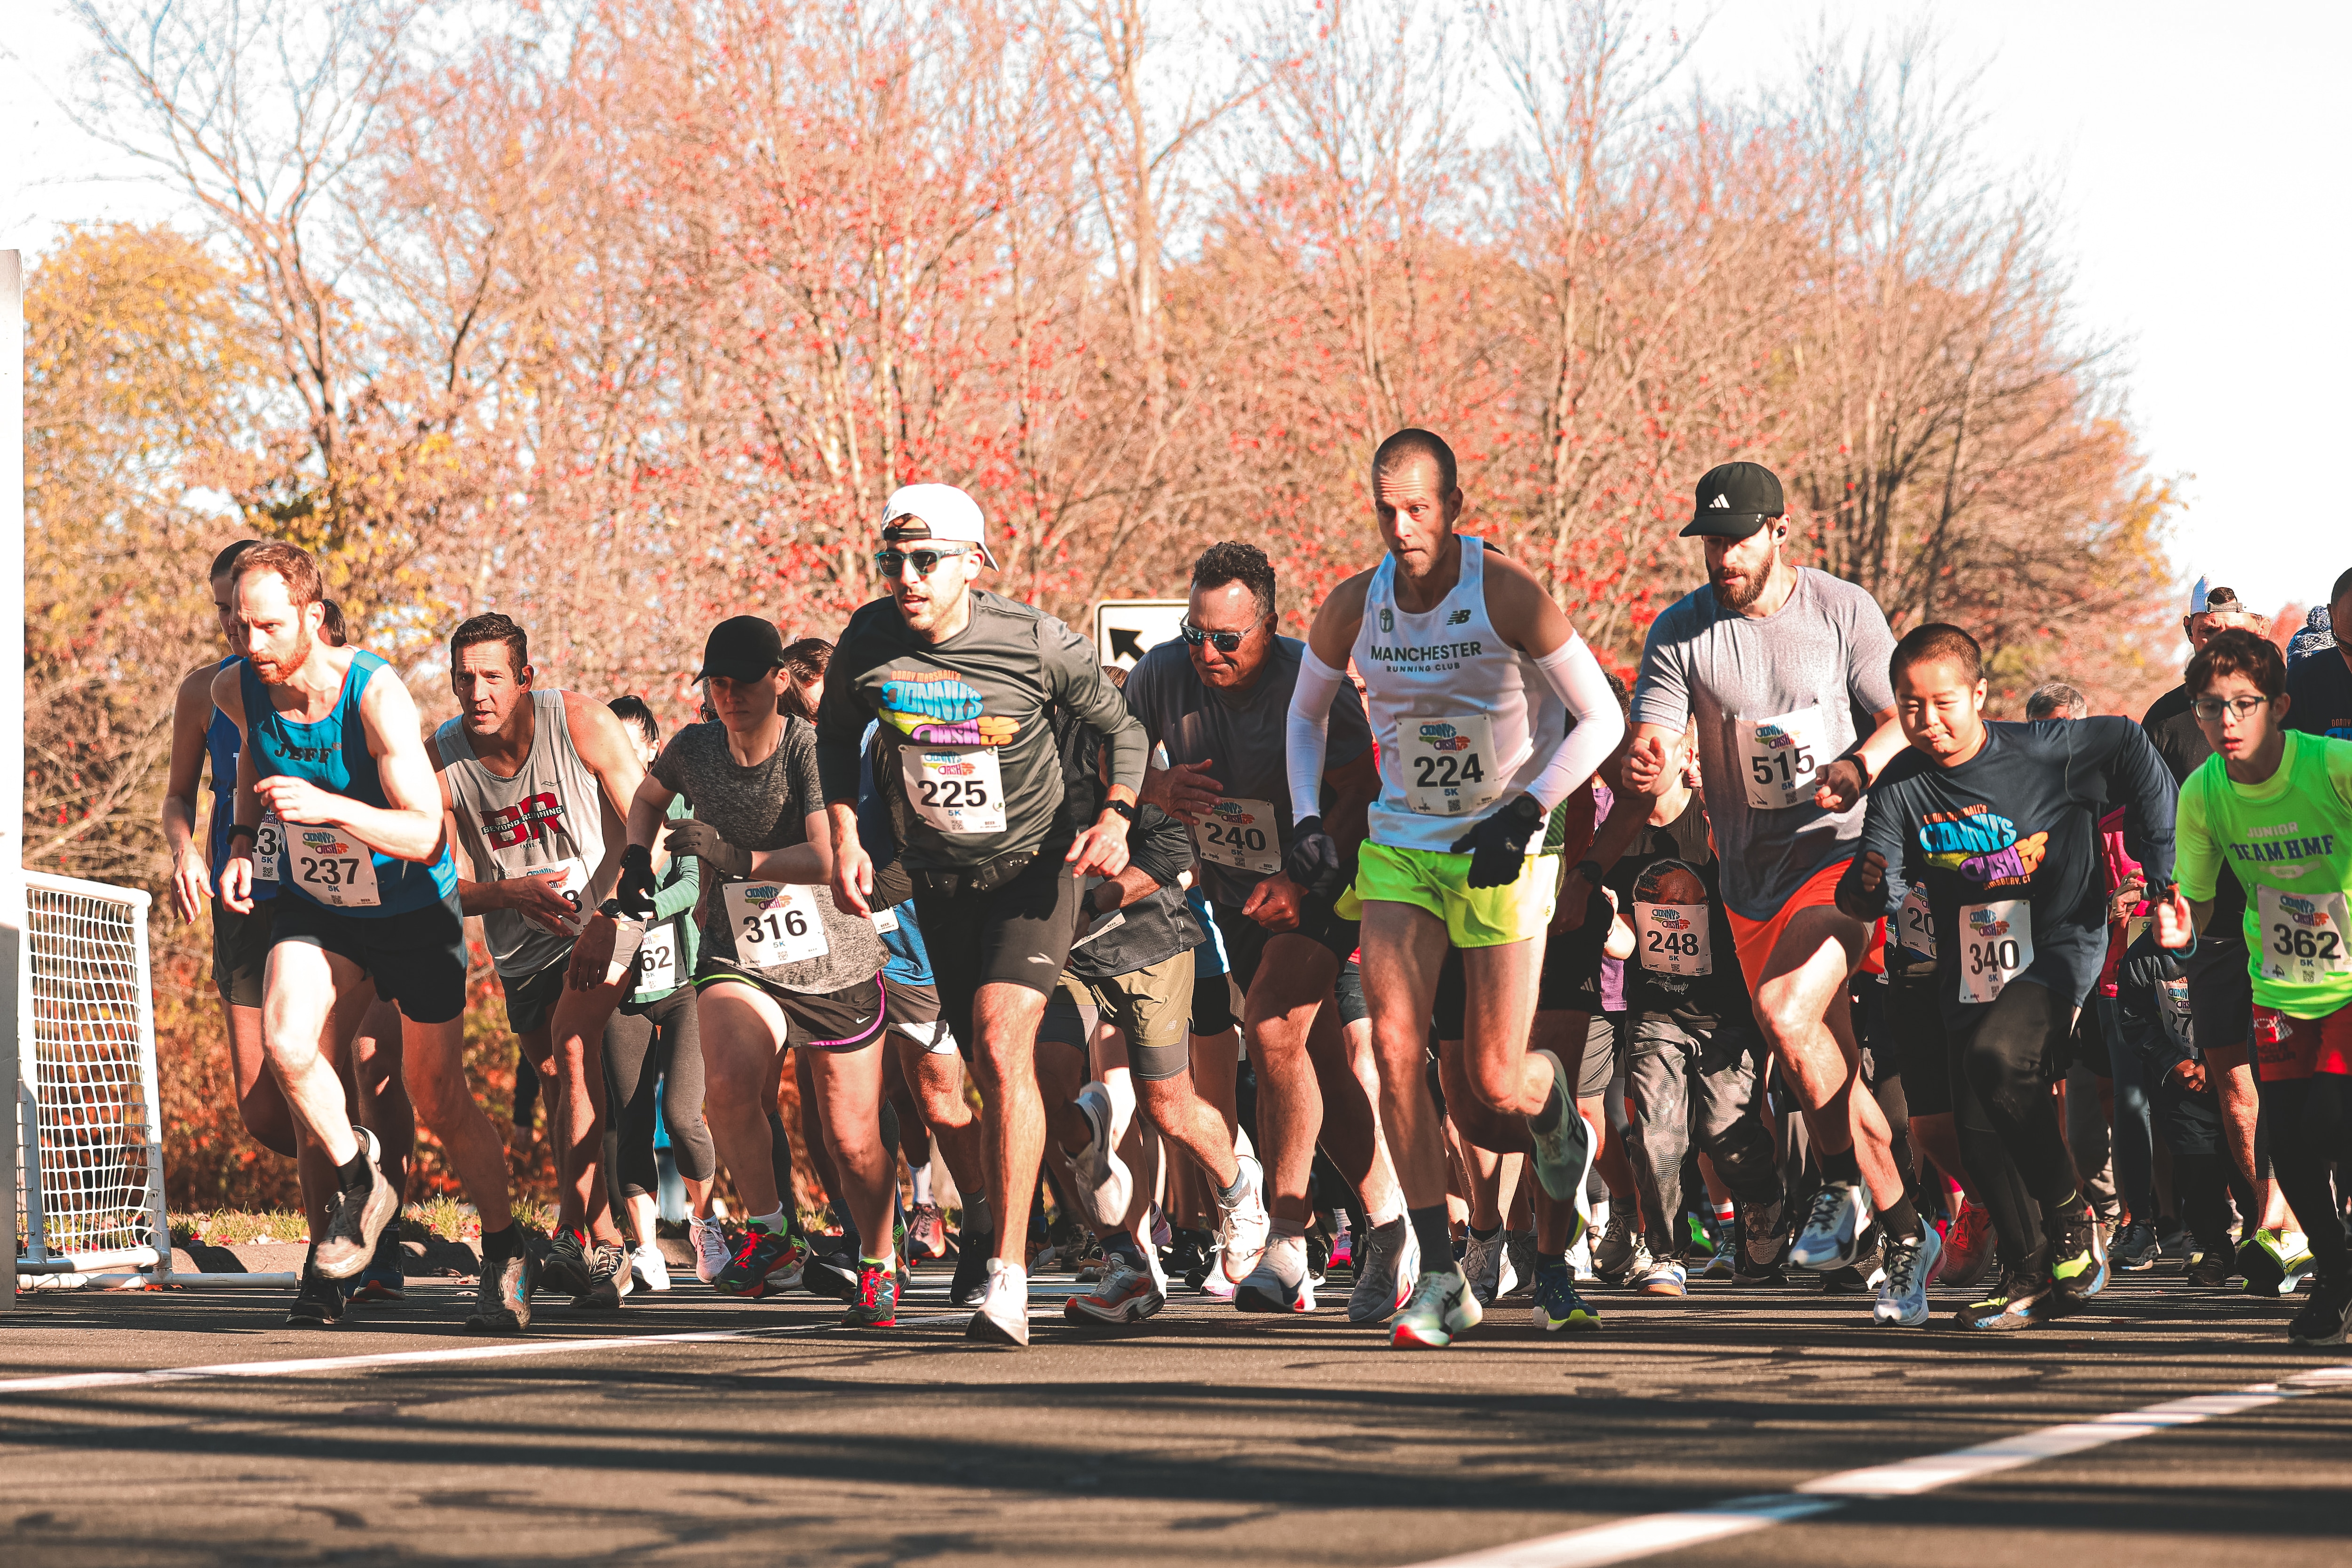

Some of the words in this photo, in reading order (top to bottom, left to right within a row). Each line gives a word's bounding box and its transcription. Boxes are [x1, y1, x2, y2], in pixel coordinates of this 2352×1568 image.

[1371, 641, 1482, 662] MANCHESTER
[891, 670, 916, 682] DONNY
[917, 670, 961, 683] MARSHALL'S
[1435, 662, 1460, 671] CLUB
[882, 680, 984, 721] DONNY'S
[912, 718, 980, 746] DASH
[2331, 718, 2351, 727] DONNY
[1414, 753, 1485, 788] 224
[1752, 745, 1815, 784] 515
[918, 780, 987, 808] 225
[1781, 781, 1795, 790] 5K
[483, 820, 520, 833] BEYOND
[522, 806, 563, 822] RUNNING
[2247, 822, 2298, 838] JUNIOR
[1204, 822, 1266, 851] 240
[301, 857, 359, 885] 237
[2023, 875, 2031, 884] CT
[743, 910, 807, 943] 316
[1652, 909, 1680, 920] DONNY'S
[1662, 919, 1680, 930] DASH
[1907, 907, 1934, 938] 20
[1647, 930, 1699, 956] 248
[2273, 923, 2341, 959] 362
[641, 946, 673, 971] 62
[1970, 940, 2020, 975] 340
[2176, 1001, 2191, 1010] DAS
[2169, 1010, 2192, 1036] 27
